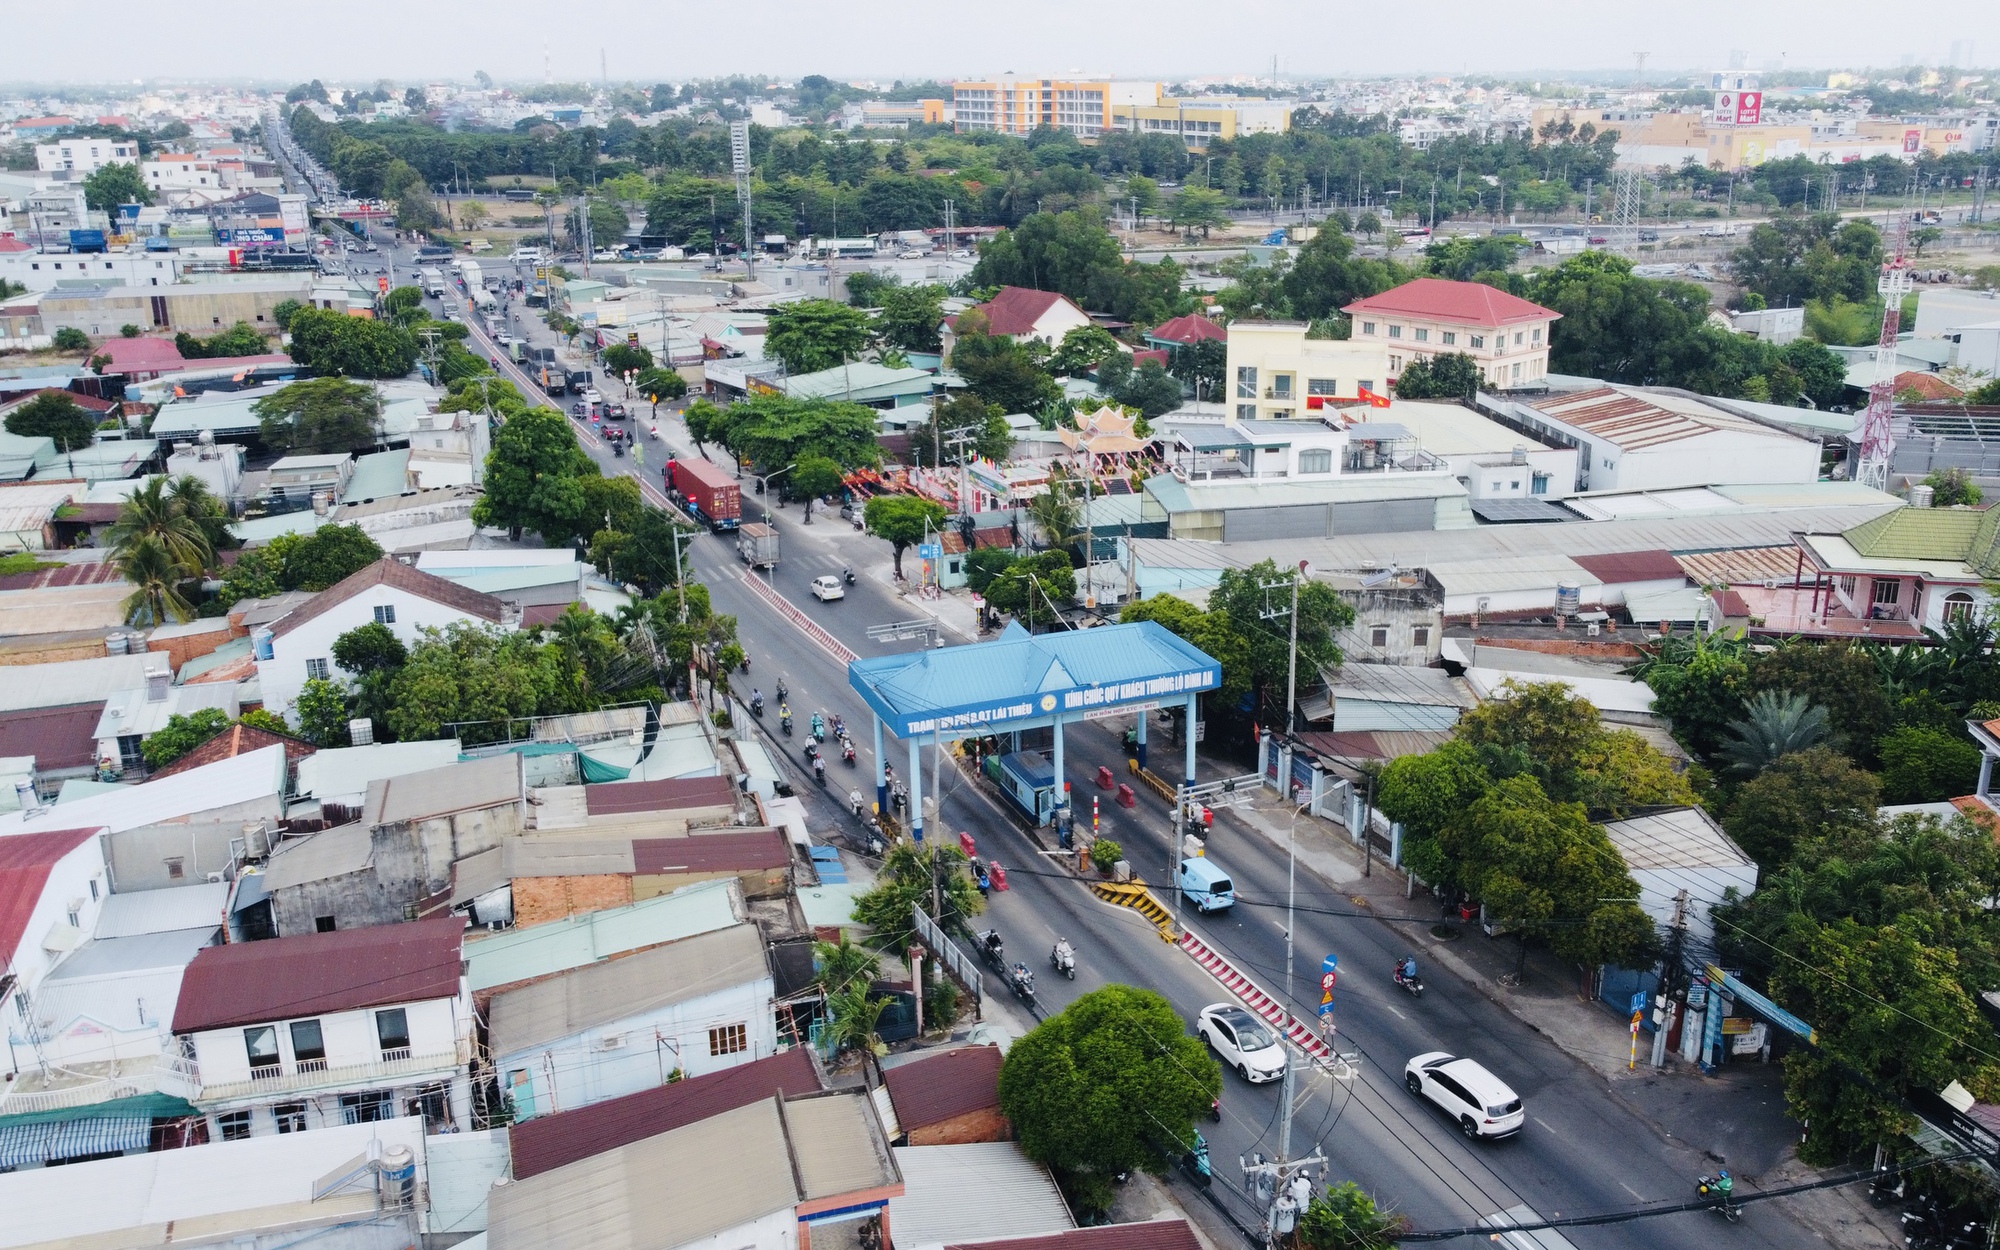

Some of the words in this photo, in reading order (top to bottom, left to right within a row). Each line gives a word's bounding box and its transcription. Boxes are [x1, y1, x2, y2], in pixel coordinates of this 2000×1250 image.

[1739, 114, 1757, 122] Mart
[1064, 690, 1083, 709] KÍNH
[1083, 687, 1104, 706] CHÚC
[1104, 684, 1119, 704] QUÝ
[1120, 680, 1146, 700] KHÁCH
[1175, 672, 1184, 693] LỘ
[1202, 670, 1213, 687] AN
[907, 719, 935, 734] TRẠM
